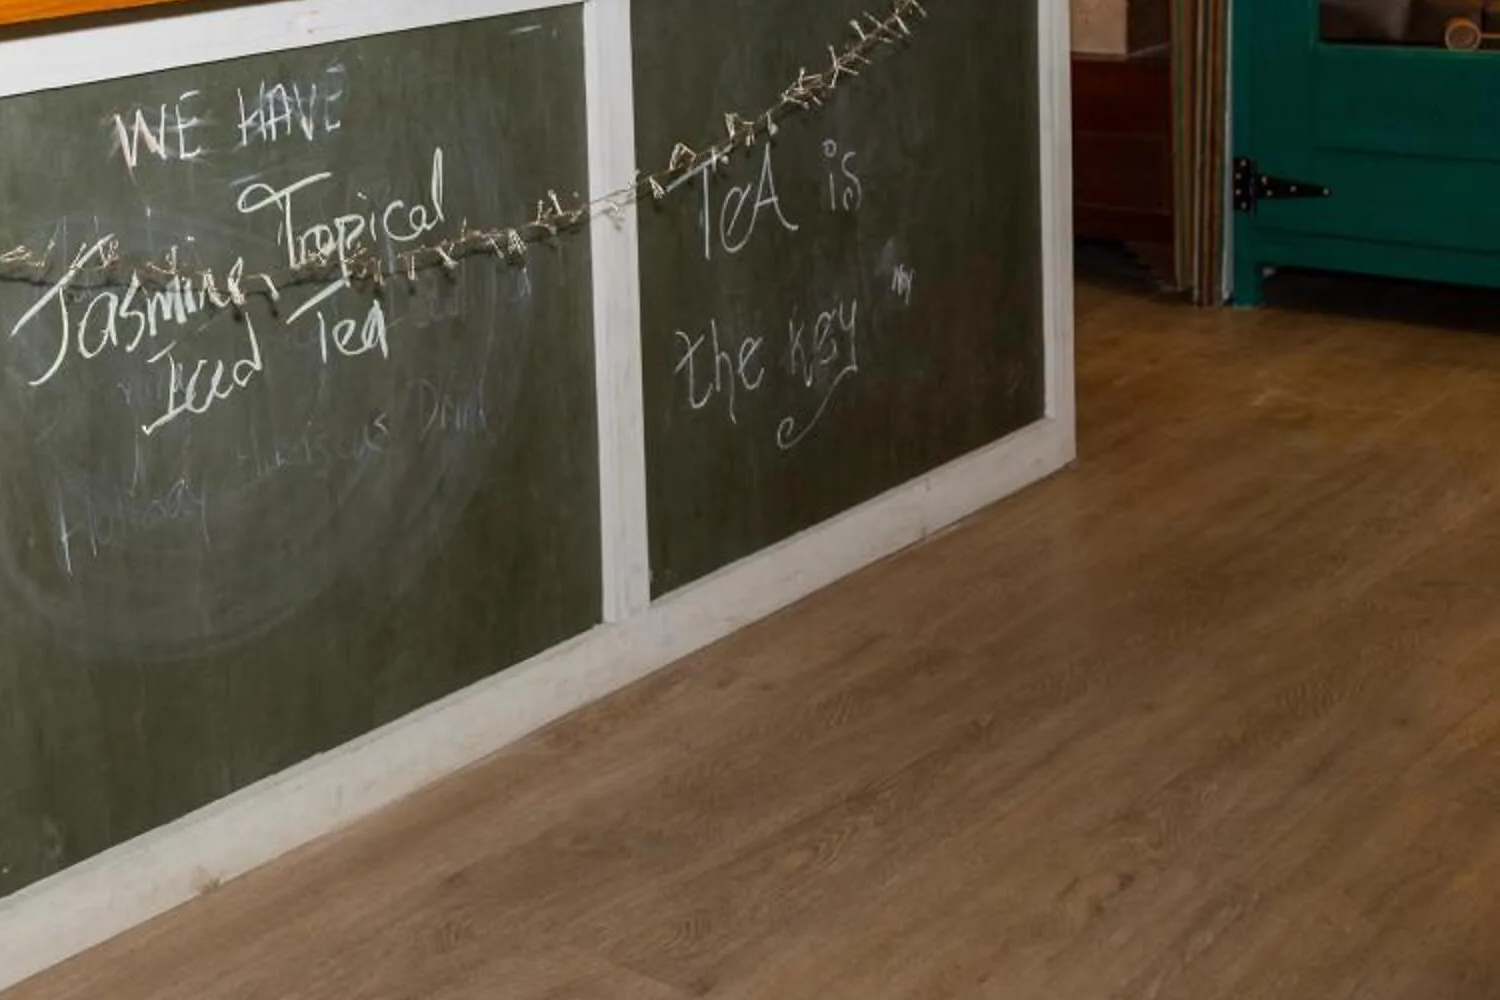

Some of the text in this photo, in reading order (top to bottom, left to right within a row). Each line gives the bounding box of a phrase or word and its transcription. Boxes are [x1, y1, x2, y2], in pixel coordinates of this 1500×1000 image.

[112, 66, 346, 169] WE HAVE
[673, 317, 765, 425] the
